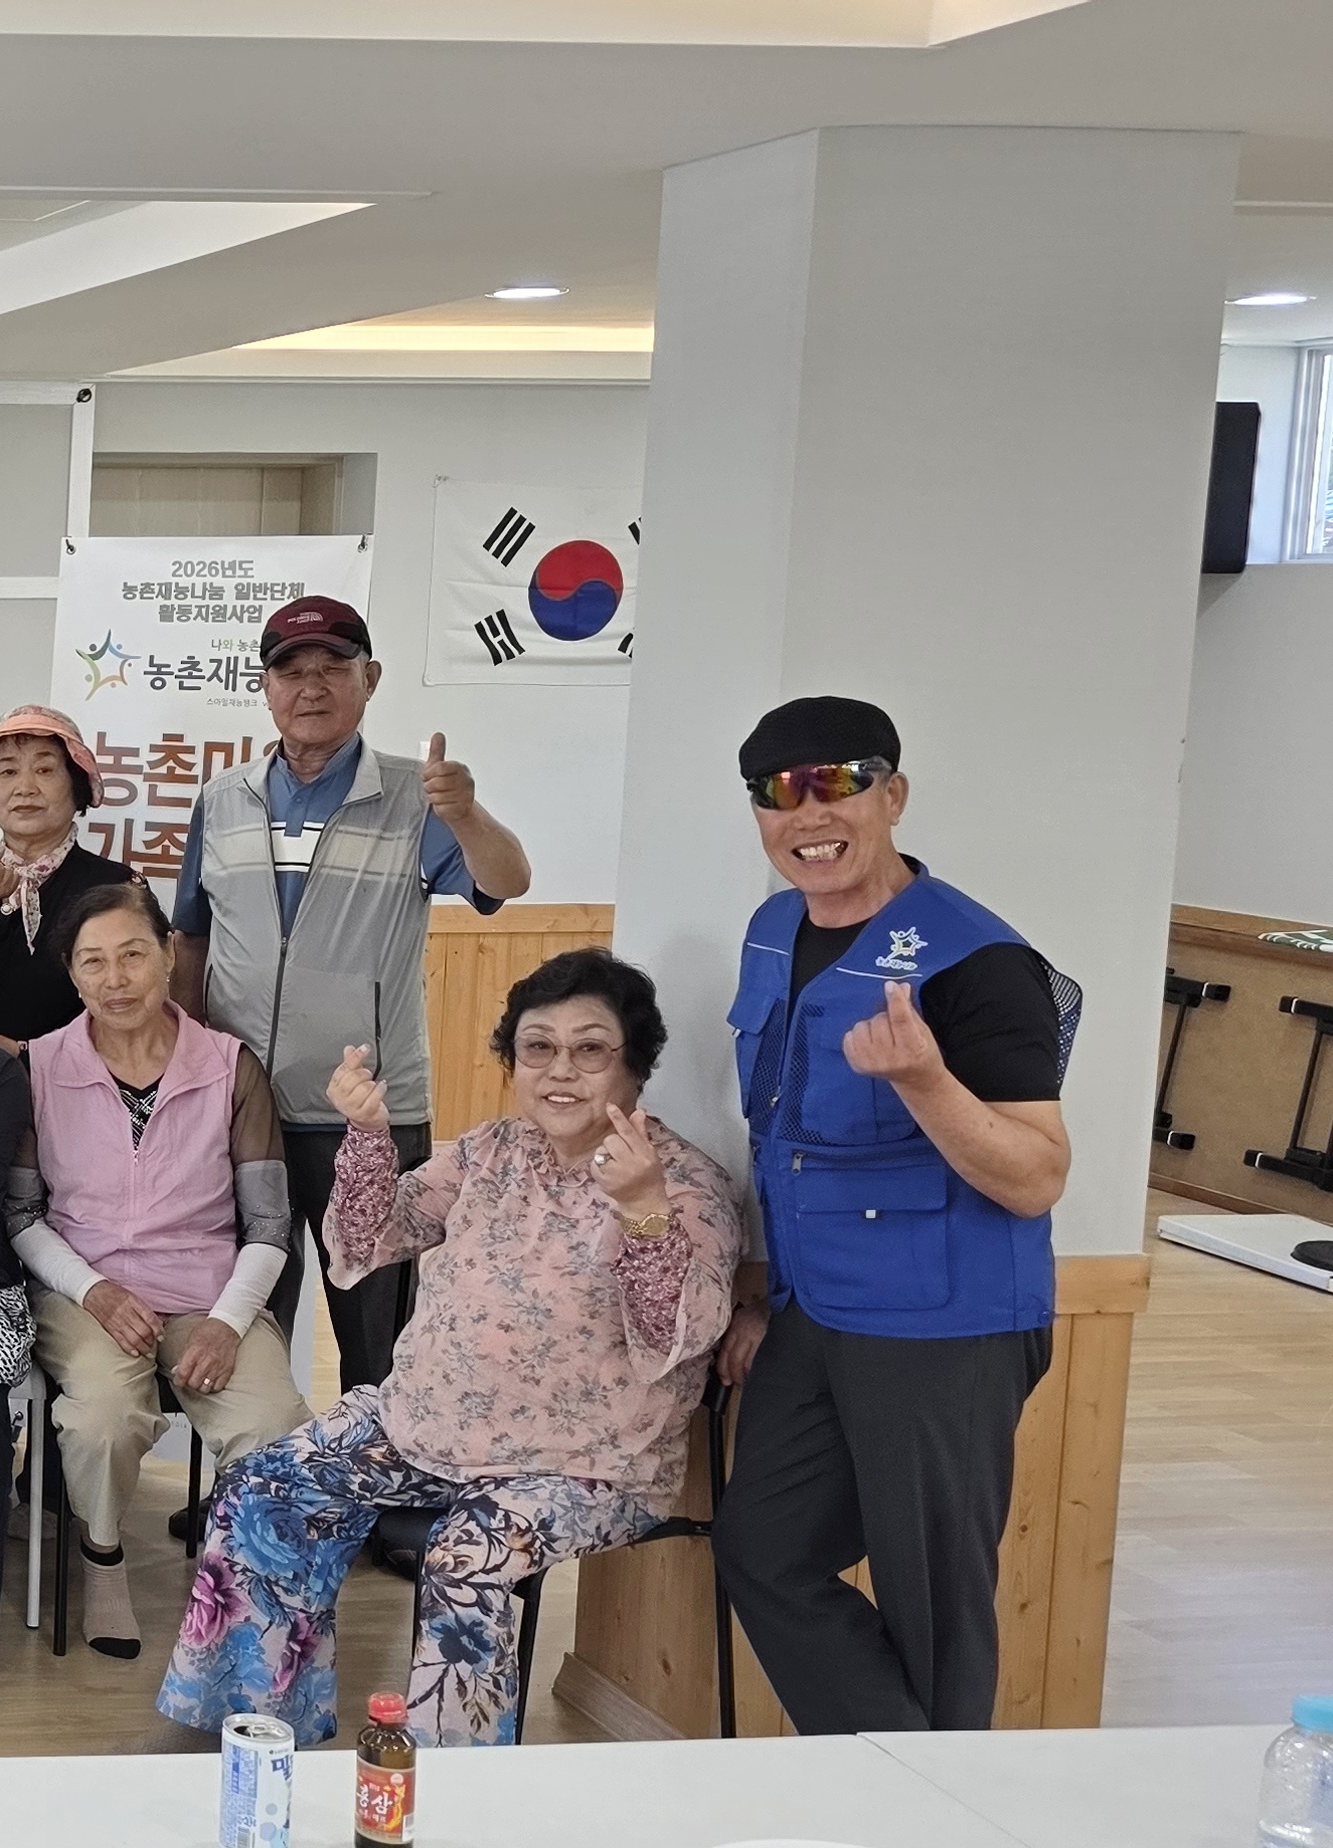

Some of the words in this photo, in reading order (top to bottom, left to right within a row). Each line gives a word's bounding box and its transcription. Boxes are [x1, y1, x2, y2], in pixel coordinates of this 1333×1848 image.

[171, 559, 255, 579] 2026년도
[121, 581, 226, 601] 농촌재능나눔
[233, 581, 306, 601] 일반단체
[158, 603, 264, 624] 활동지원사업
[210, 639, 235, 651] 나와
[237, 639, 261, 653] 농촌
[143, 654, 266, 693] 농촌재능
